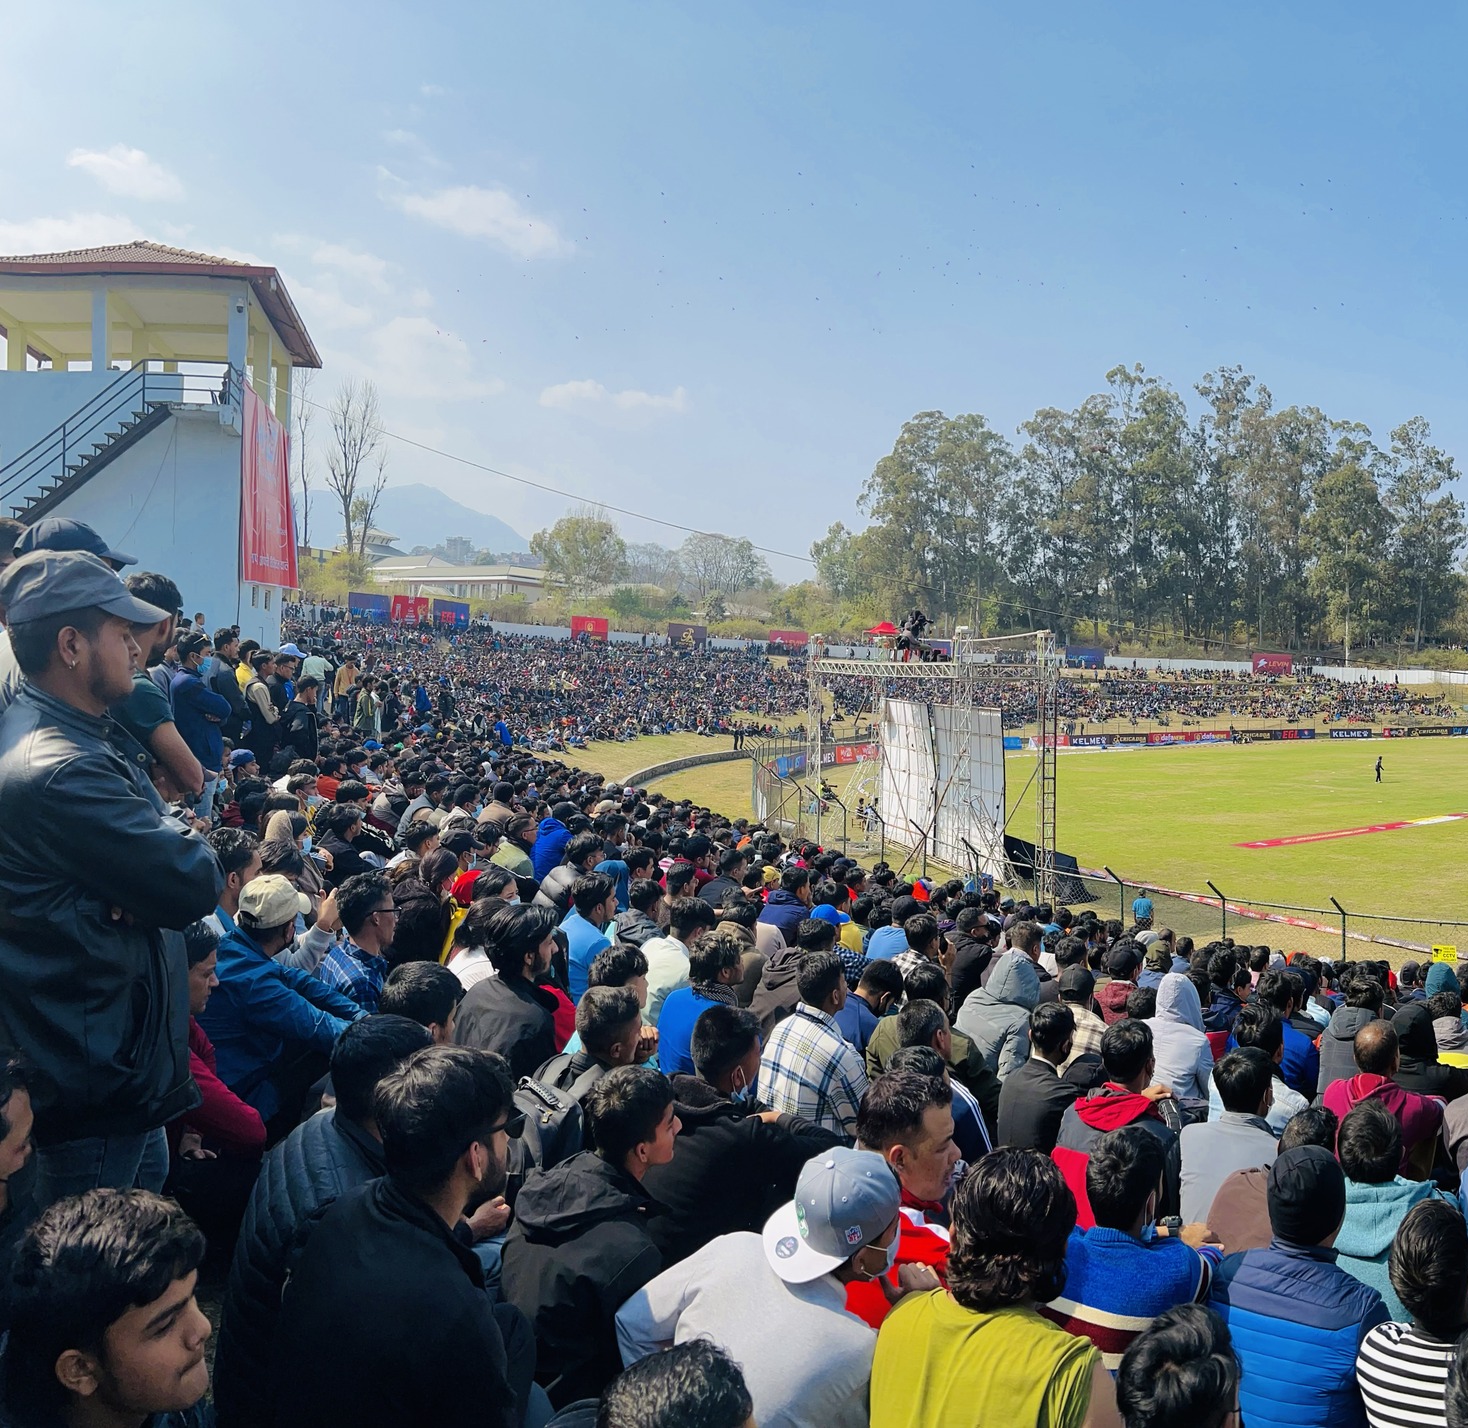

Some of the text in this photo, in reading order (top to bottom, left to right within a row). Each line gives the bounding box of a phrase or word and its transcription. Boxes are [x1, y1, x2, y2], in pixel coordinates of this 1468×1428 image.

[1282, 730, 1300, 739] EGL
[1333, 730, 1363, 738] KELME
[1072, 736, 1101, 745] KELME
